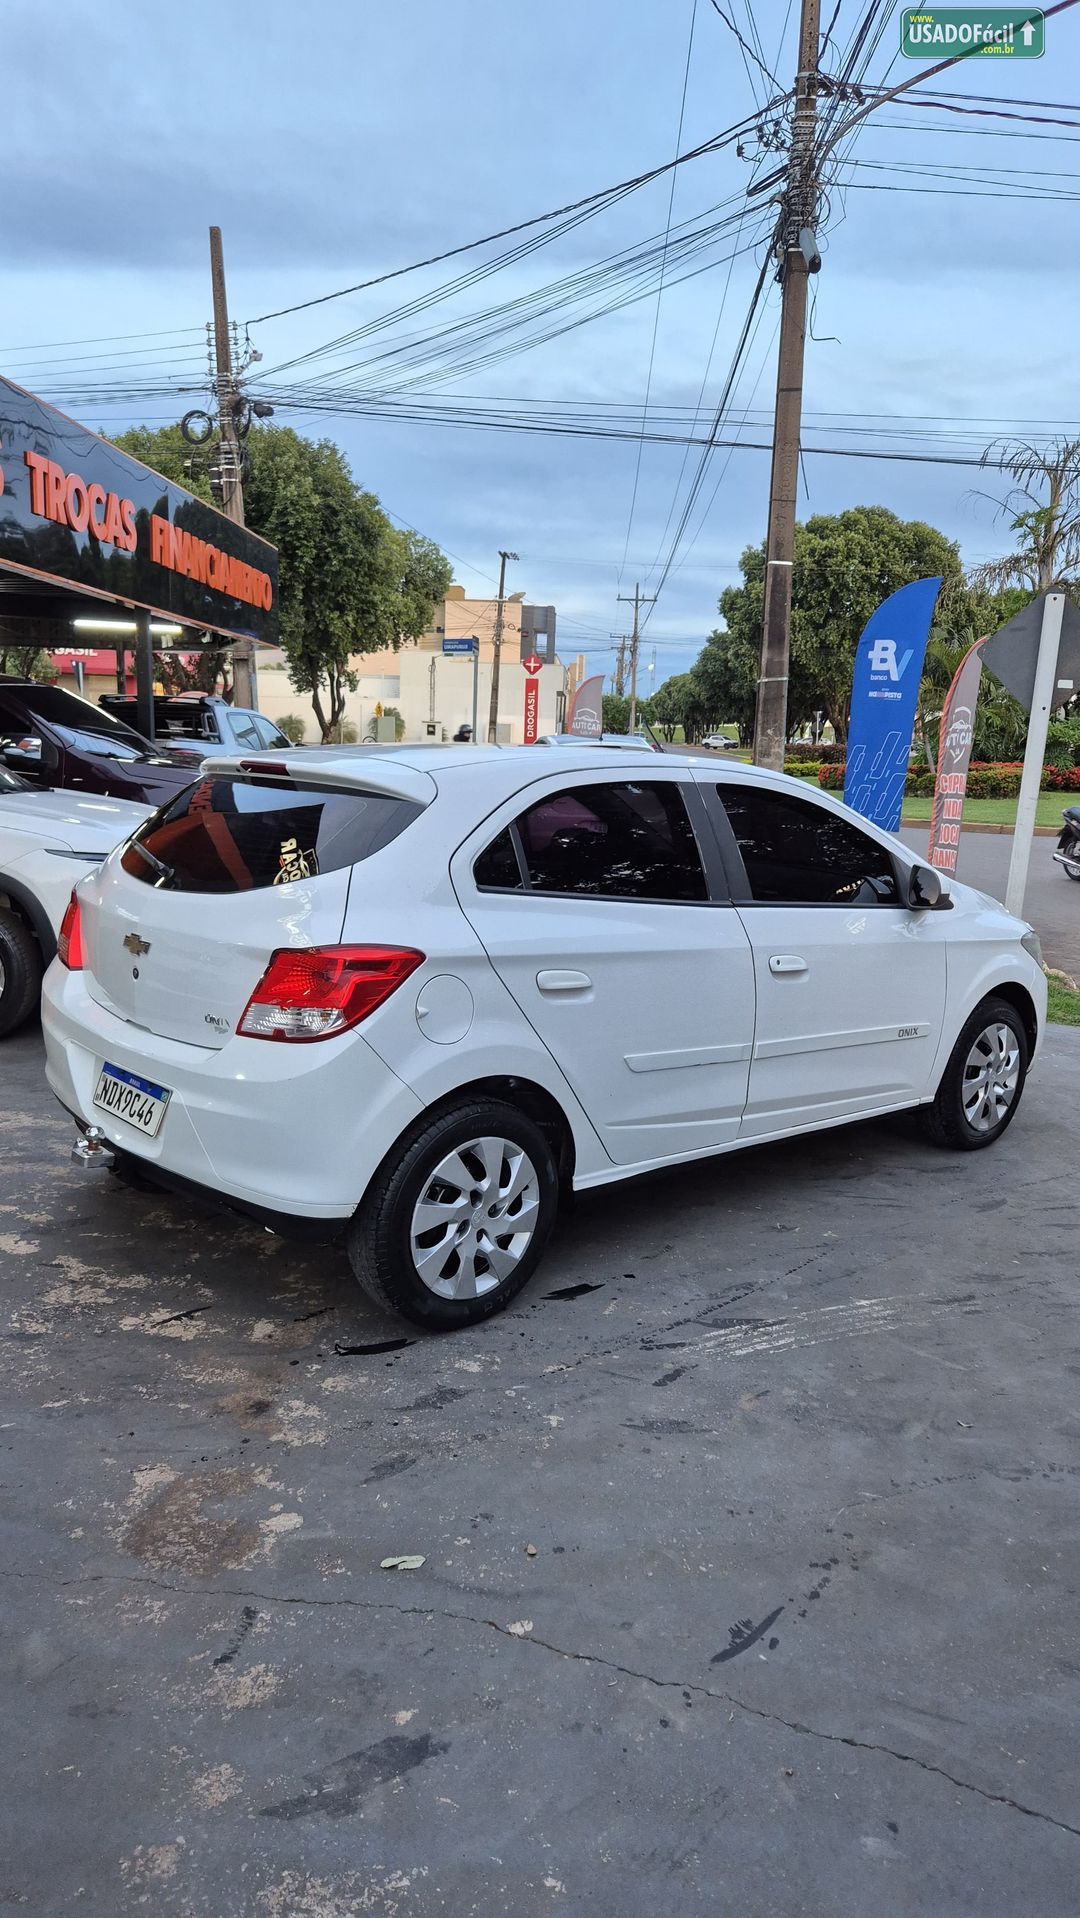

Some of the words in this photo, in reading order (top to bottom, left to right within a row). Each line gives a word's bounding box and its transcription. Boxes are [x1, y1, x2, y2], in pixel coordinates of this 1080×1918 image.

[24, 451, 138, 552] TROCAS
[150, 513, 273, 612] FINANCIAMENTO
[526, 689, 536, 738] DROGASIL
[897, 1027, 919, 1038] ONIX
[99, 1078, 156, 1127] NDX9C46
